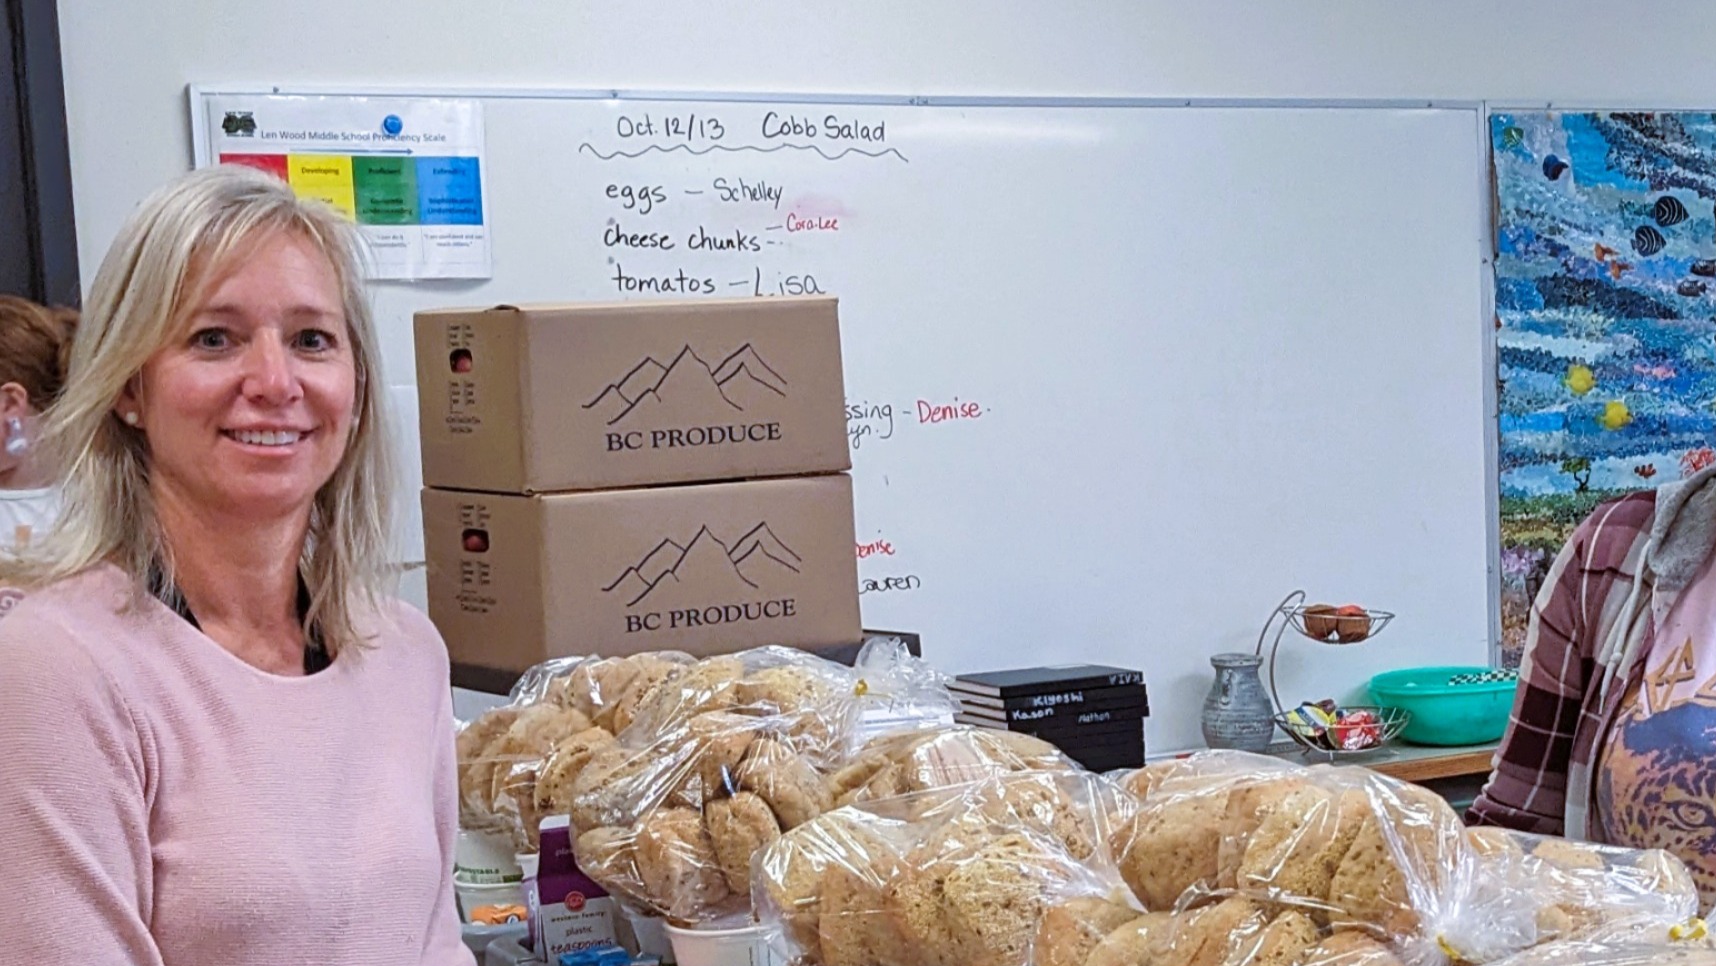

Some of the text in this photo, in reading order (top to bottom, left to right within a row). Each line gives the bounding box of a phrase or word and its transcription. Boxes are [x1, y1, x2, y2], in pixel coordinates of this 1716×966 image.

[260, 130, 277, 140] Len
[280, 130, 306, 140] Wood
[309, 131, 339, 141] Middle
[341, 132, 370, 142] School
[423, 133, 446, 142] Scale
[617, 111, 886, 142] Oct. 12/13 Cobb Salad
[605, 176, 784, 215] eggs Schelley
[604, 223, 762, 252] cheese chunks
[612, 263, 717, 294] tomatos
[605, 421, 783, 452] BC PRODUCE
[625, 598, 797, 633] BC PRODUCE
[566, 926, 593, 937] plastic
